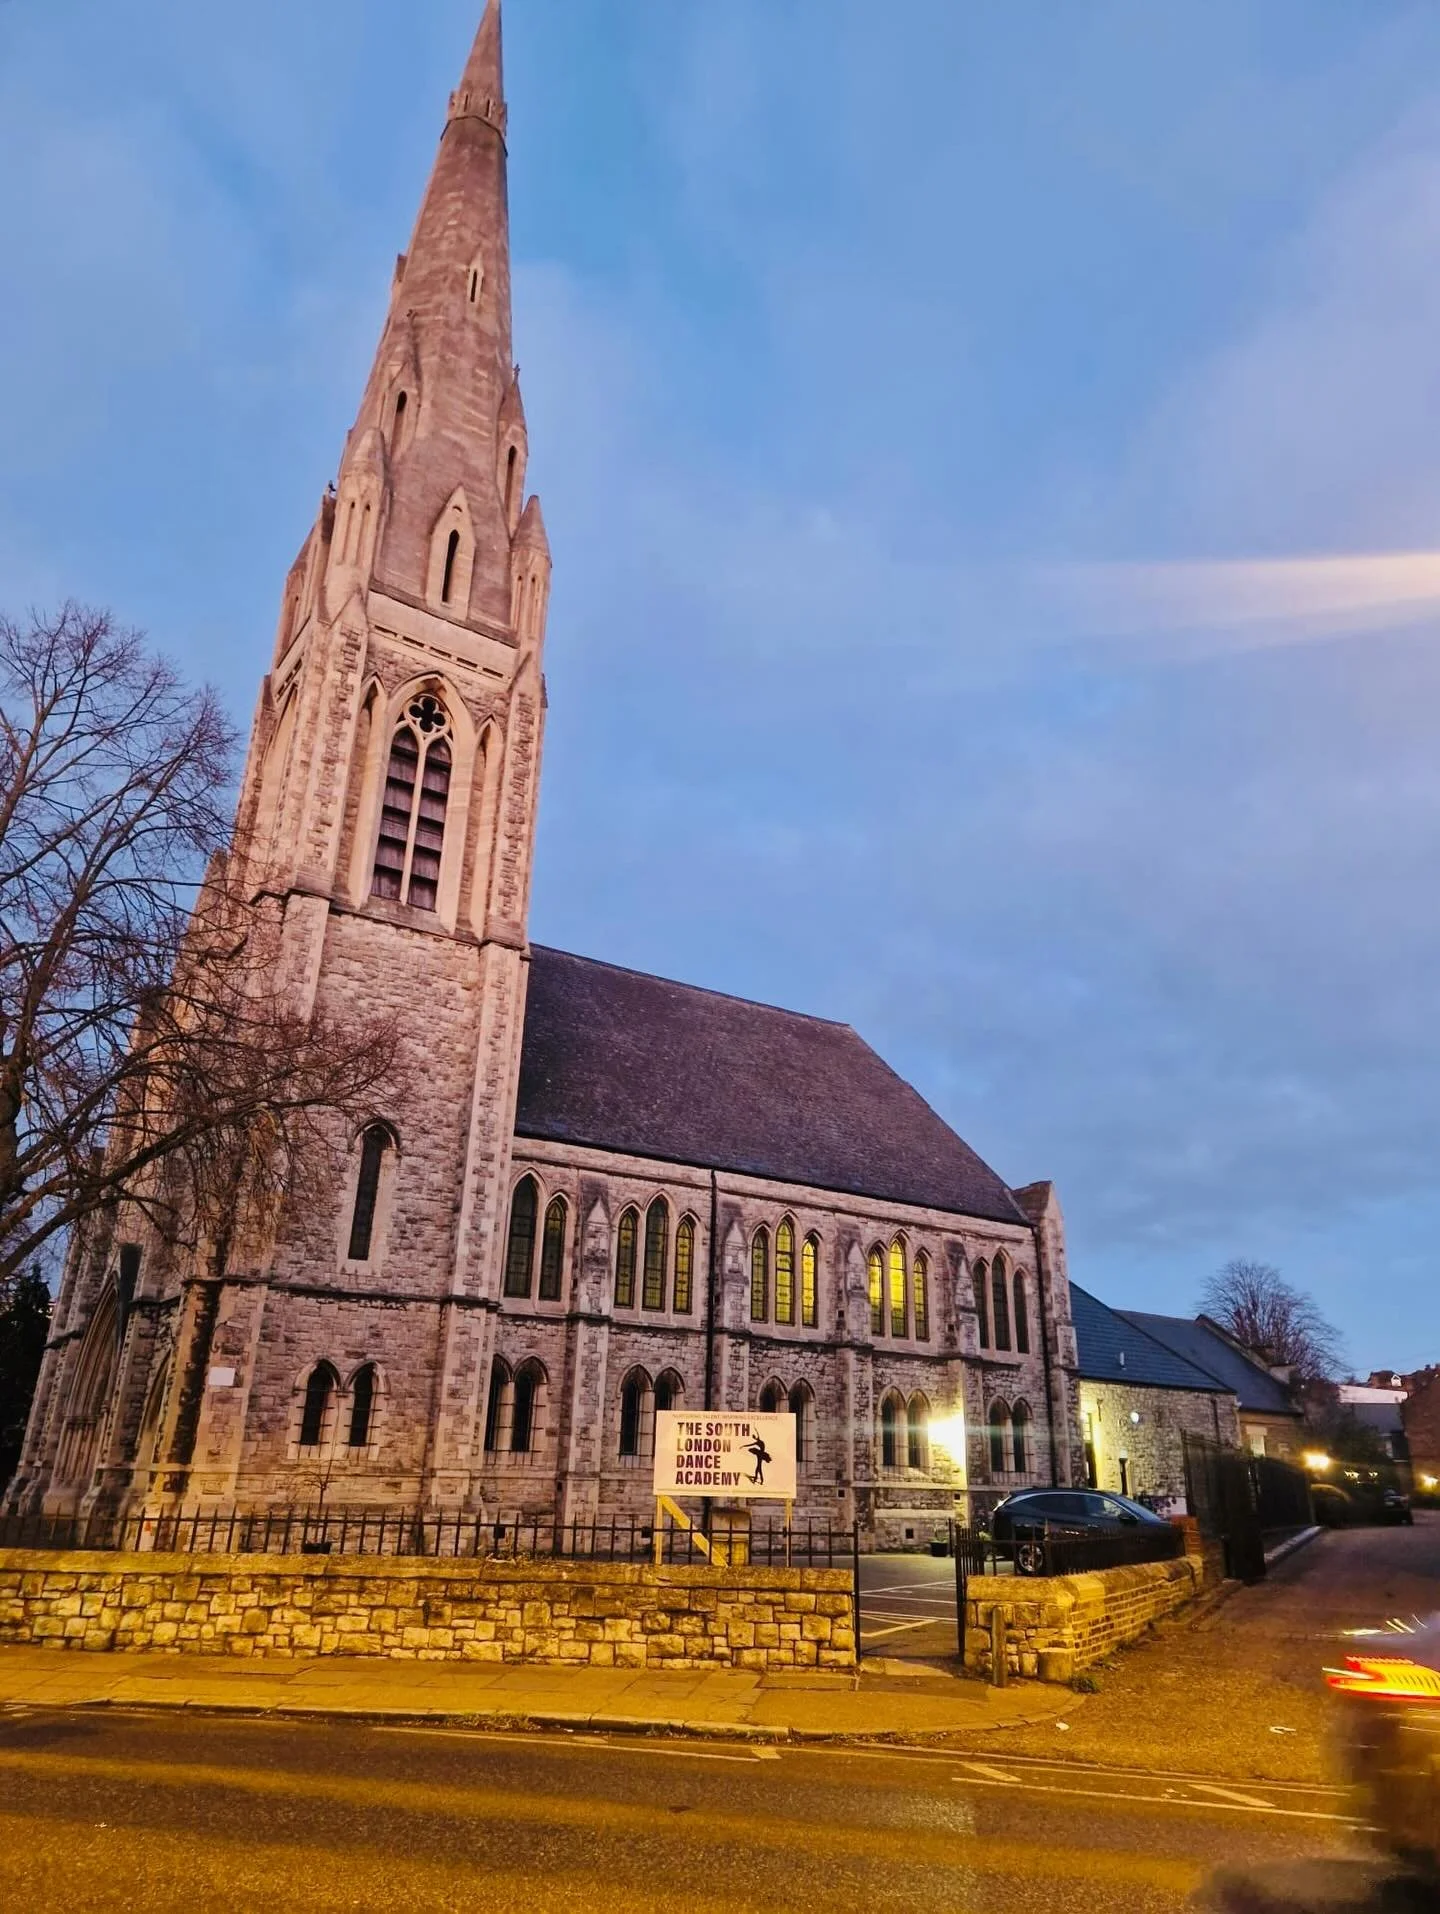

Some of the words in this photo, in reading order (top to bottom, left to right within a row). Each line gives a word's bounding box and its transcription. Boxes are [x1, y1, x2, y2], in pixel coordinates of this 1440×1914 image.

[677, 1422, 702, 1436] THE
[706, 1422, 750, 1437] SOUTH
[677, 1438, 731, 1453] LONDON
[676, 1455, 721, 1469] DANCE
[675, 1471, 741, 1486] ACADEMY
